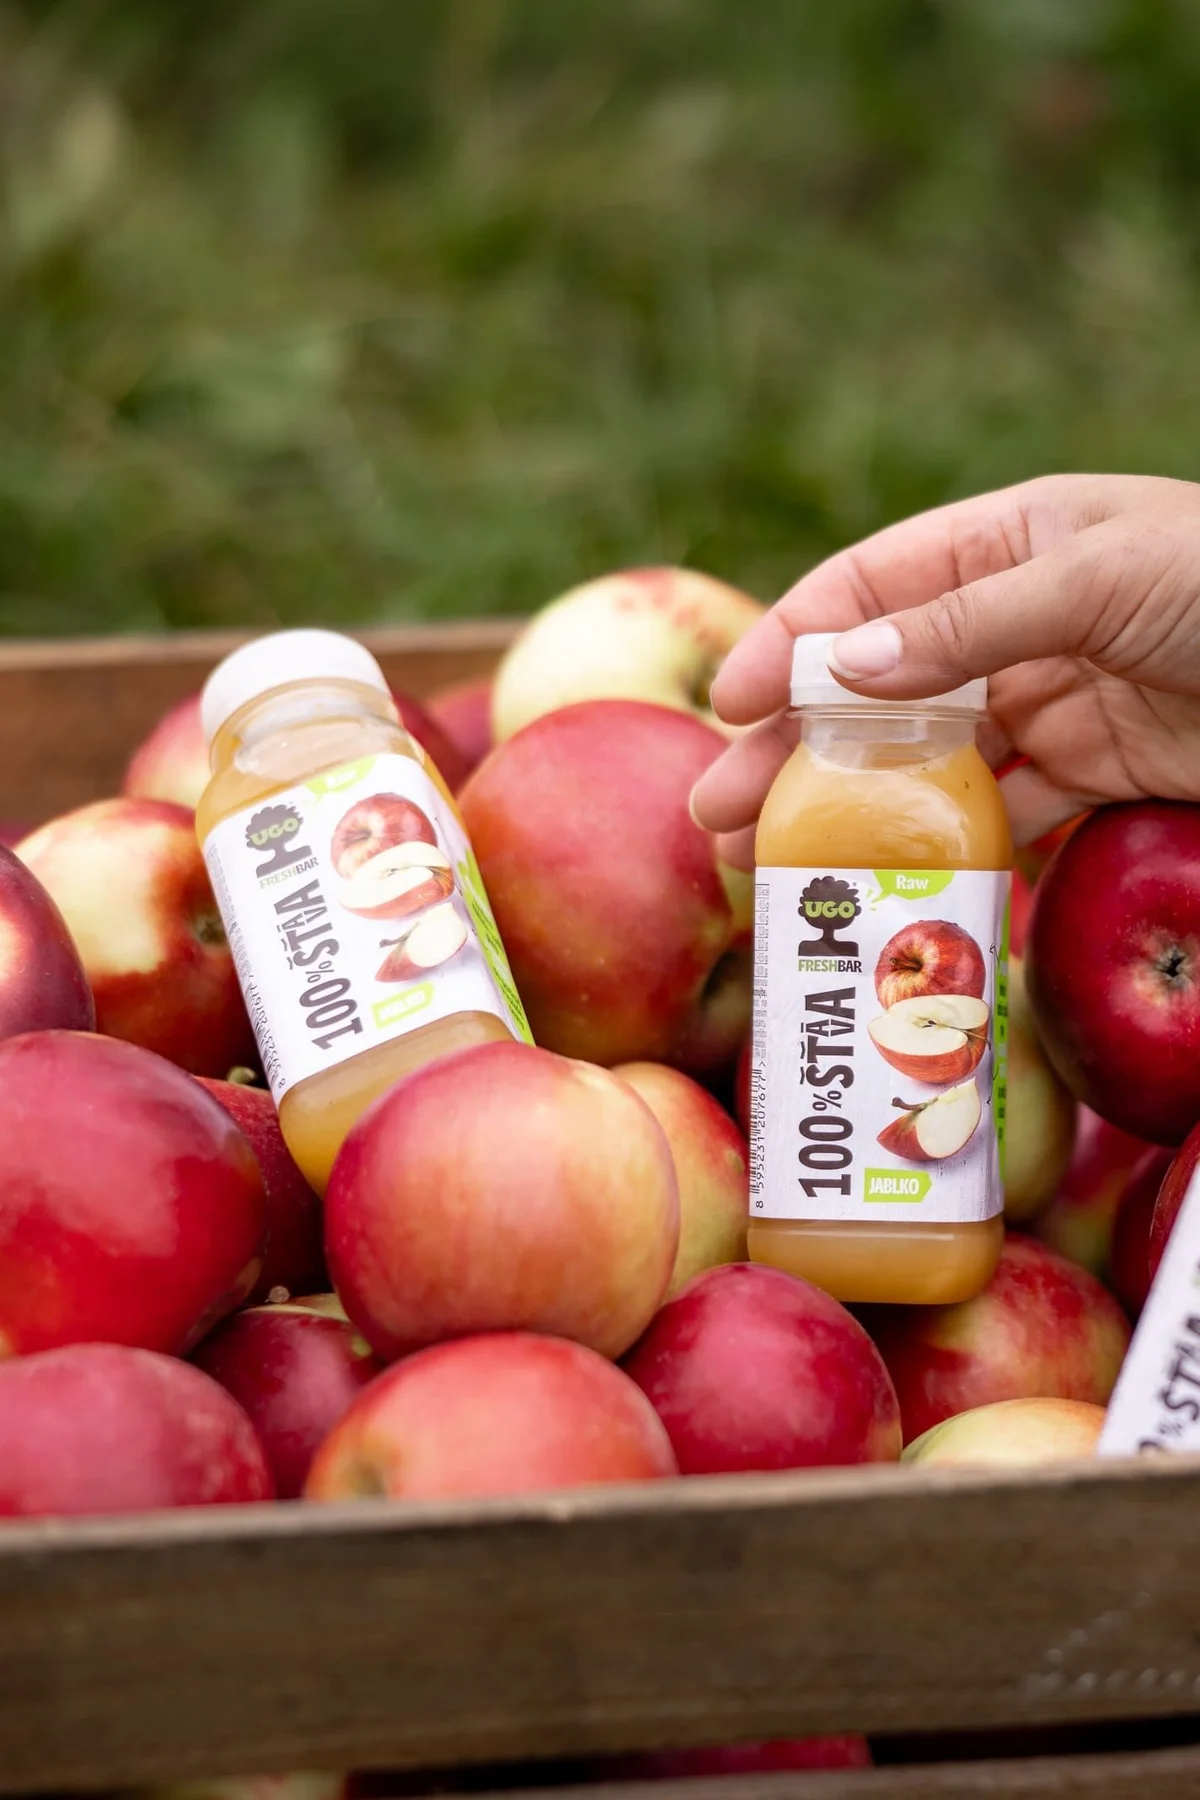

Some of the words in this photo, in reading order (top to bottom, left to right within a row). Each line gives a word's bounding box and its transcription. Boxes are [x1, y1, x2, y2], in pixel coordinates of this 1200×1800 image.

[249, 816, 299, 847] UGO
[259, 857, 319, 890] FRESHBAR
[896, 875, 929, 890] Raw
[804, 900, 856, 918] UGO
[798, 959, 862, 973] FRESHBAR
[757, 1074, 766, 1128] 207677
[869, 1177, 920, 1196] JABLKO
[755, 1200, 764, 1209] 8
